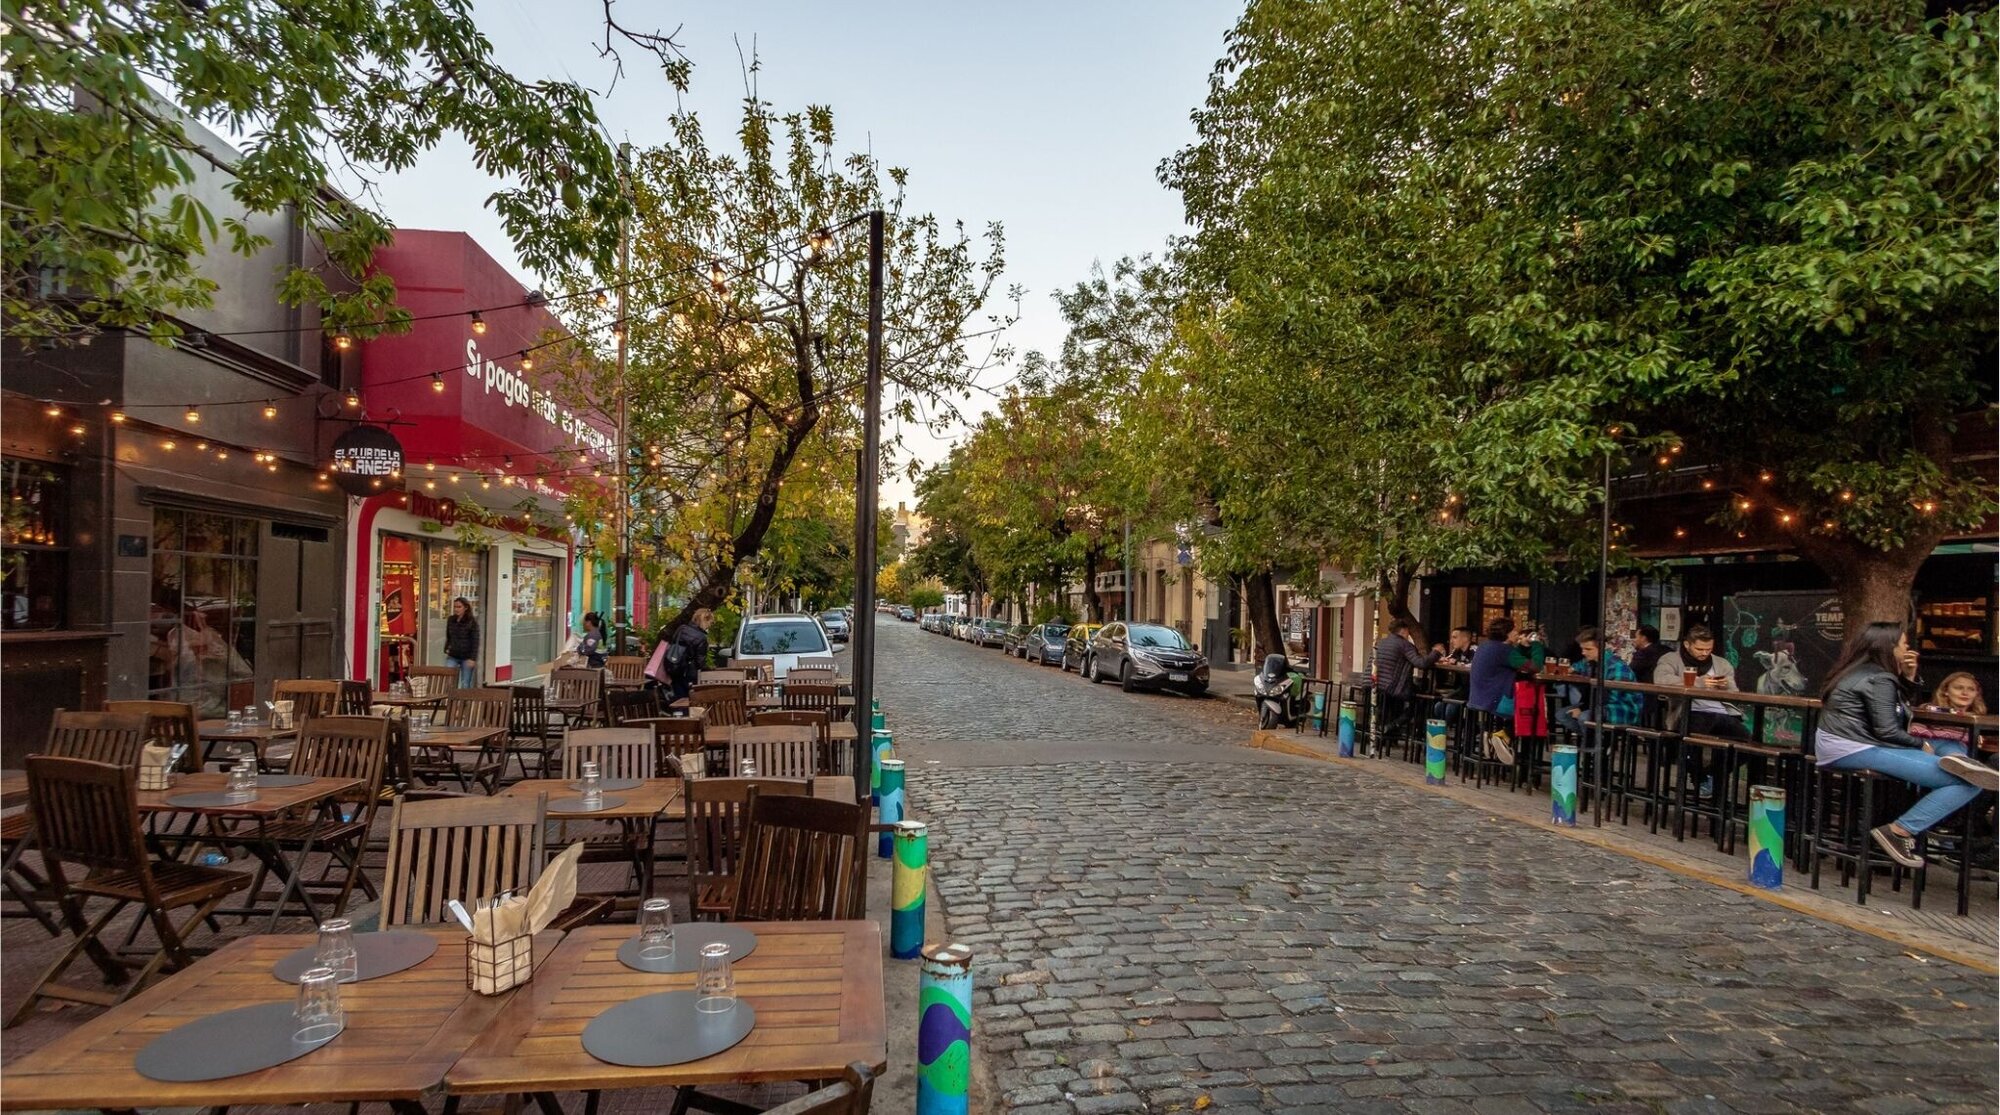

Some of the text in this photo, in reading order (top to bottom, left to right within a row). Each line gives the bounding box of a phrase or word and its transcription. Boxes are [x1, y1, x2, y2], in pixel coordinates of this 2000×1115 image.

[485, 359, 529, 408] pagás
[562, 410, 573, 434] es
[335, 447, 400, 461] EL CLUB DE LA
[335, 459, 401, 475] MILANESA
